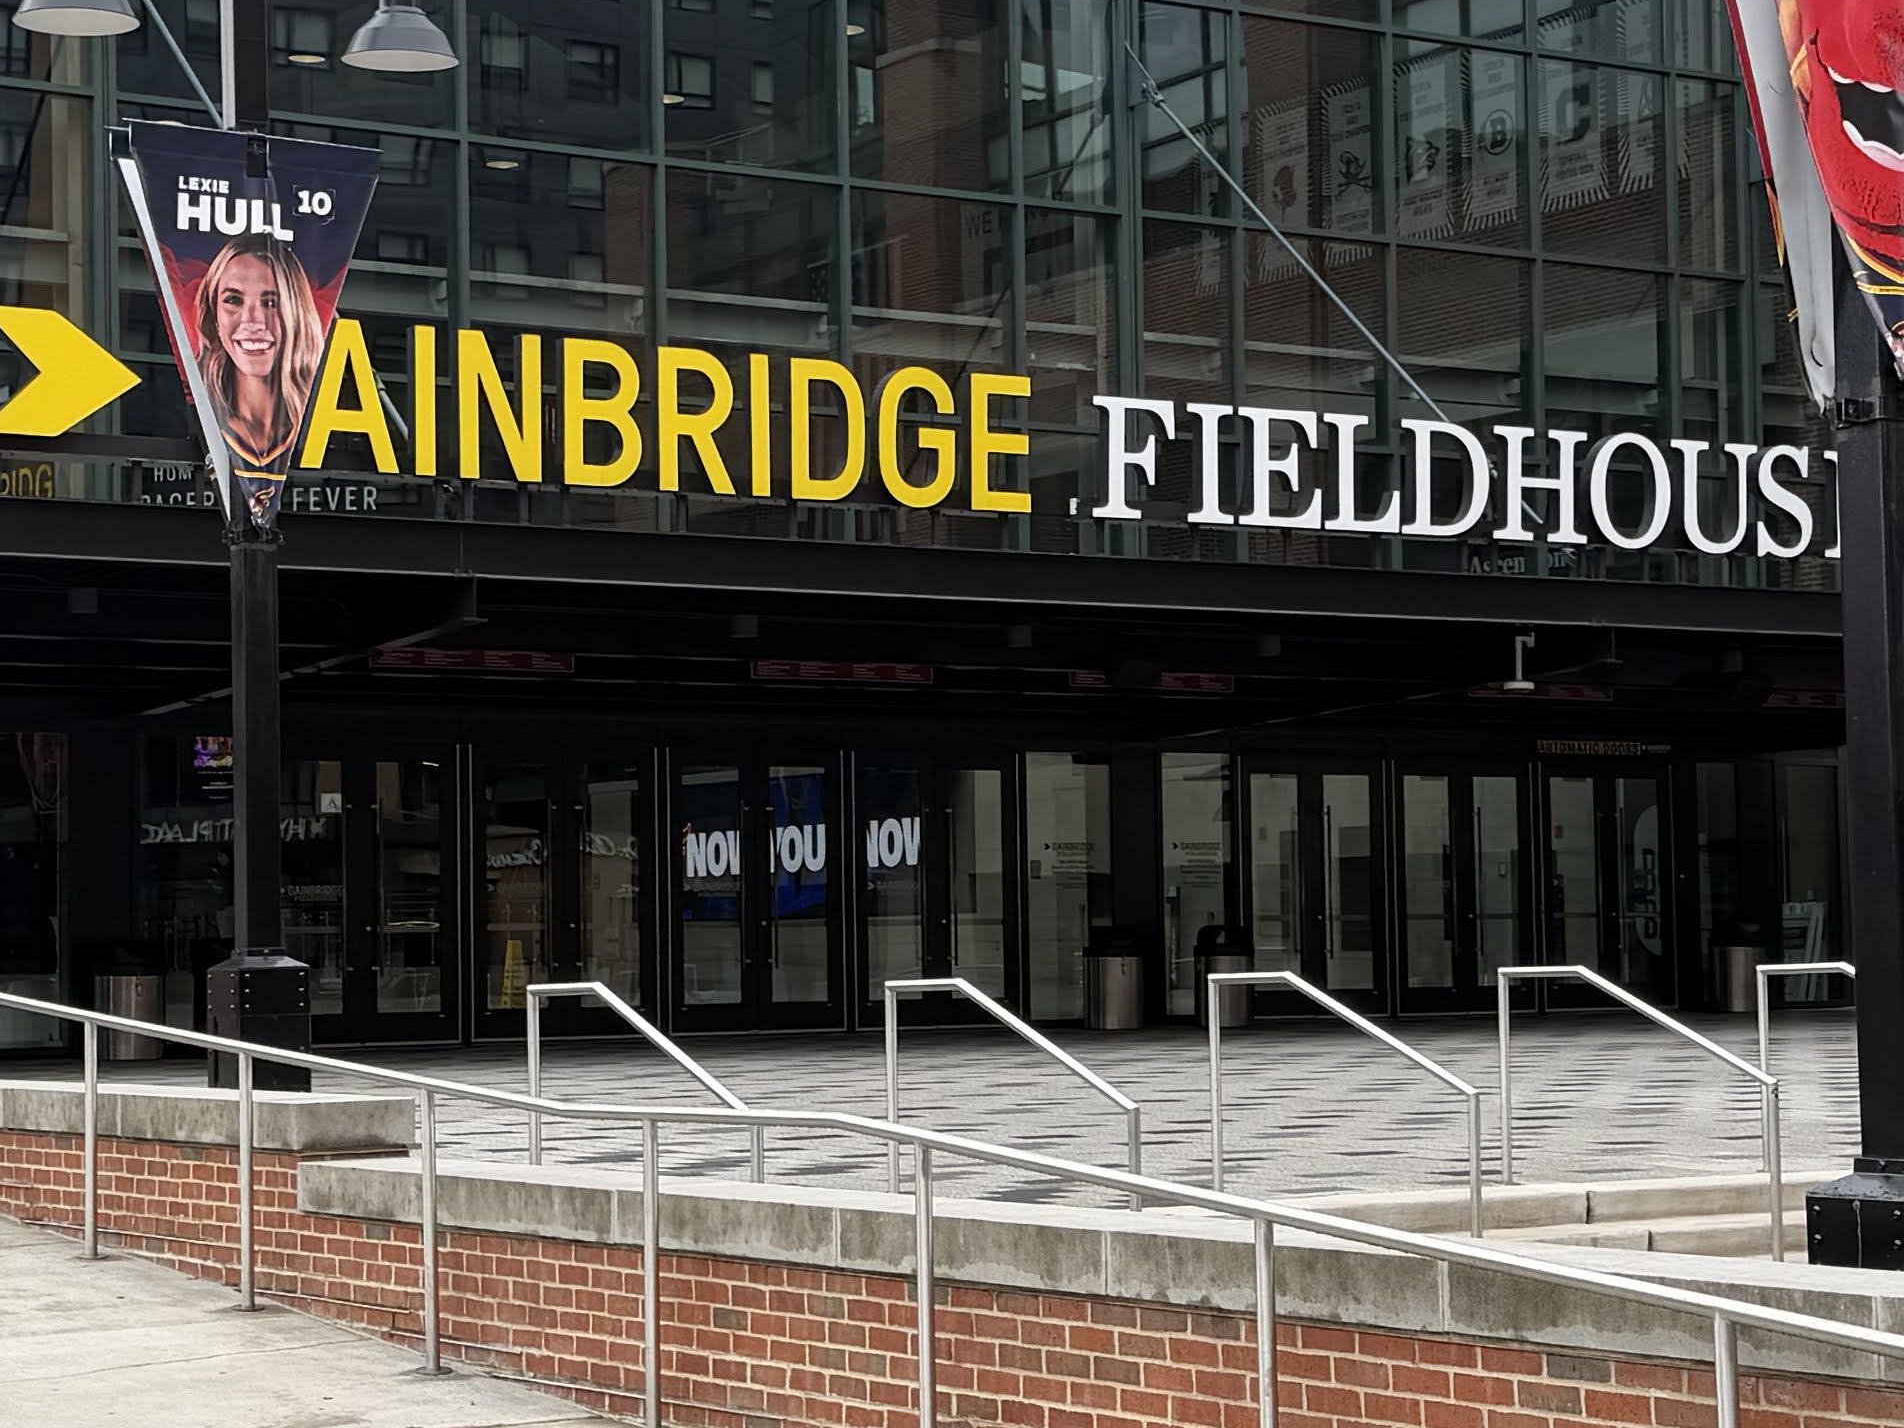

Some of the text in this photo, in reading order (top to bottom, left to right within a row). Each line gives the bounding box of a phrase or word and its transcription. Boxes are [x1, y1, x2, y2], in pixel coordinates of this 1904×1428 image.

[178, 175, 230, 195] LEXIE
[176, 189, 333, 242] HULL 10
[300, 318, 1841, 559] AINBRIDGE FIELDHOUS
[292, 485, 378, 512] FEVER
